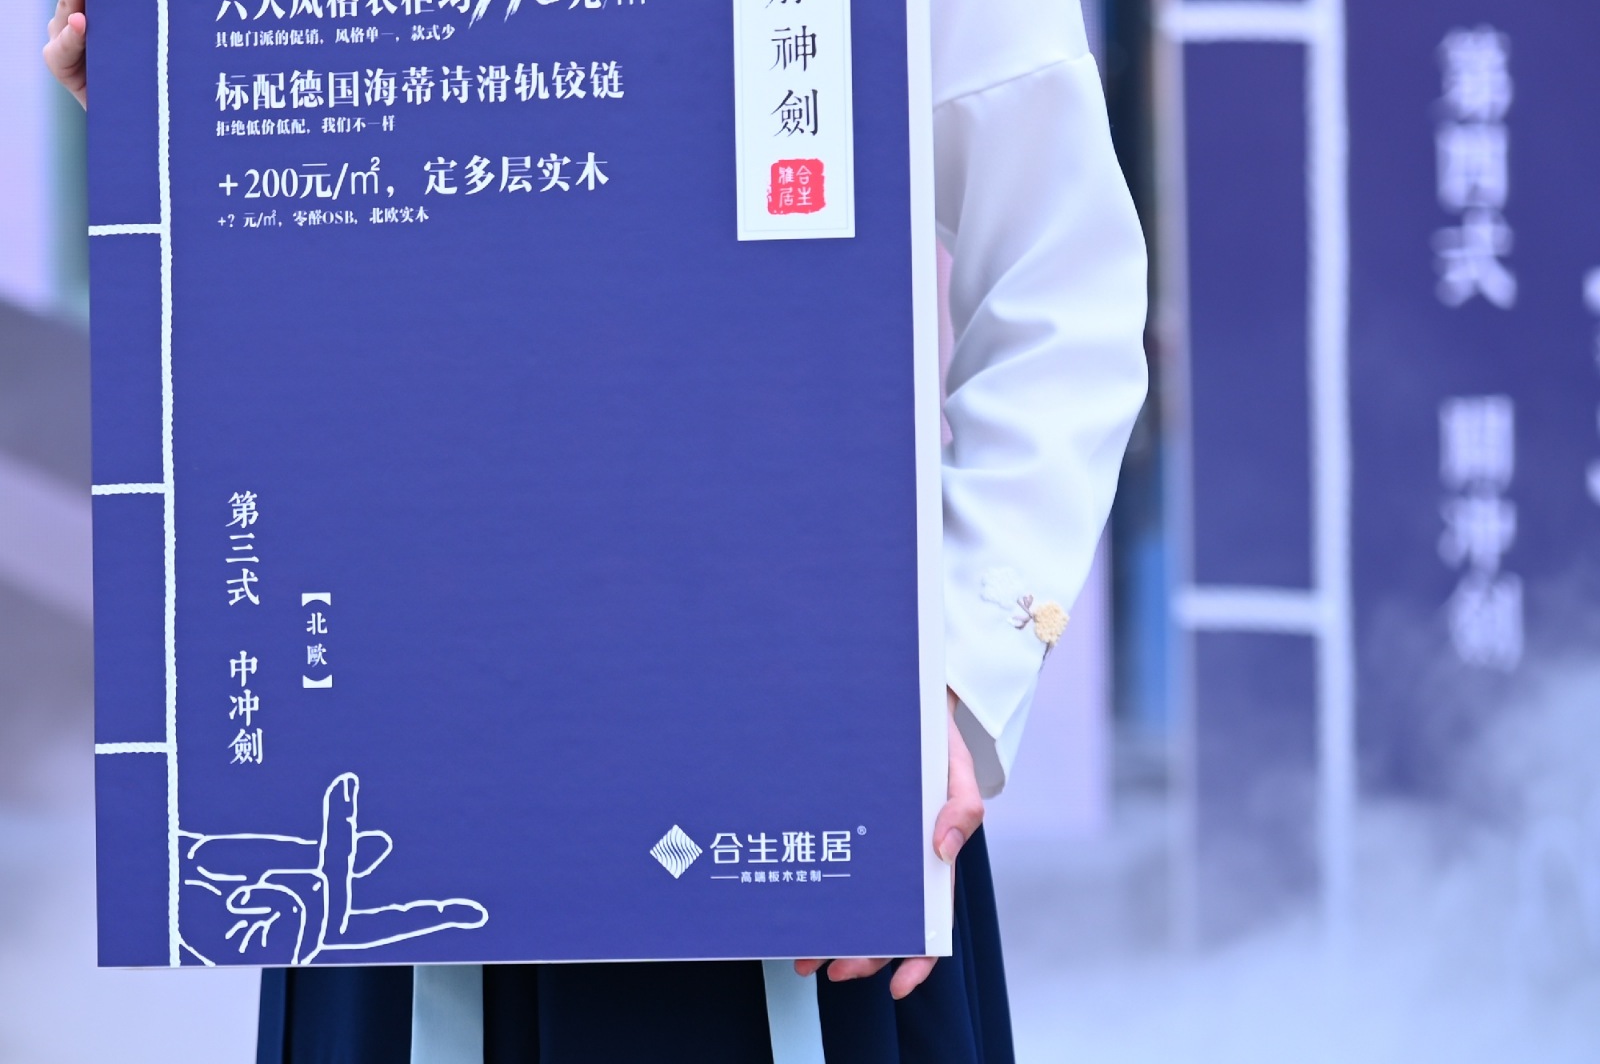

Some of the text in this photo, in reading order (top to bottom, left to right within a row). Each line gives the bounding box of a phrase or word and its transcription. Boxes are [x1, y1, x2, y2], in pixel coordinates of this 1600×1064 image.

[215, 60, 626, 112] 标配德国海蒂诗滑轨铰链
[225, 490, 261, 607] 第三式
[709, 830, 852, 864] 合生雅居
